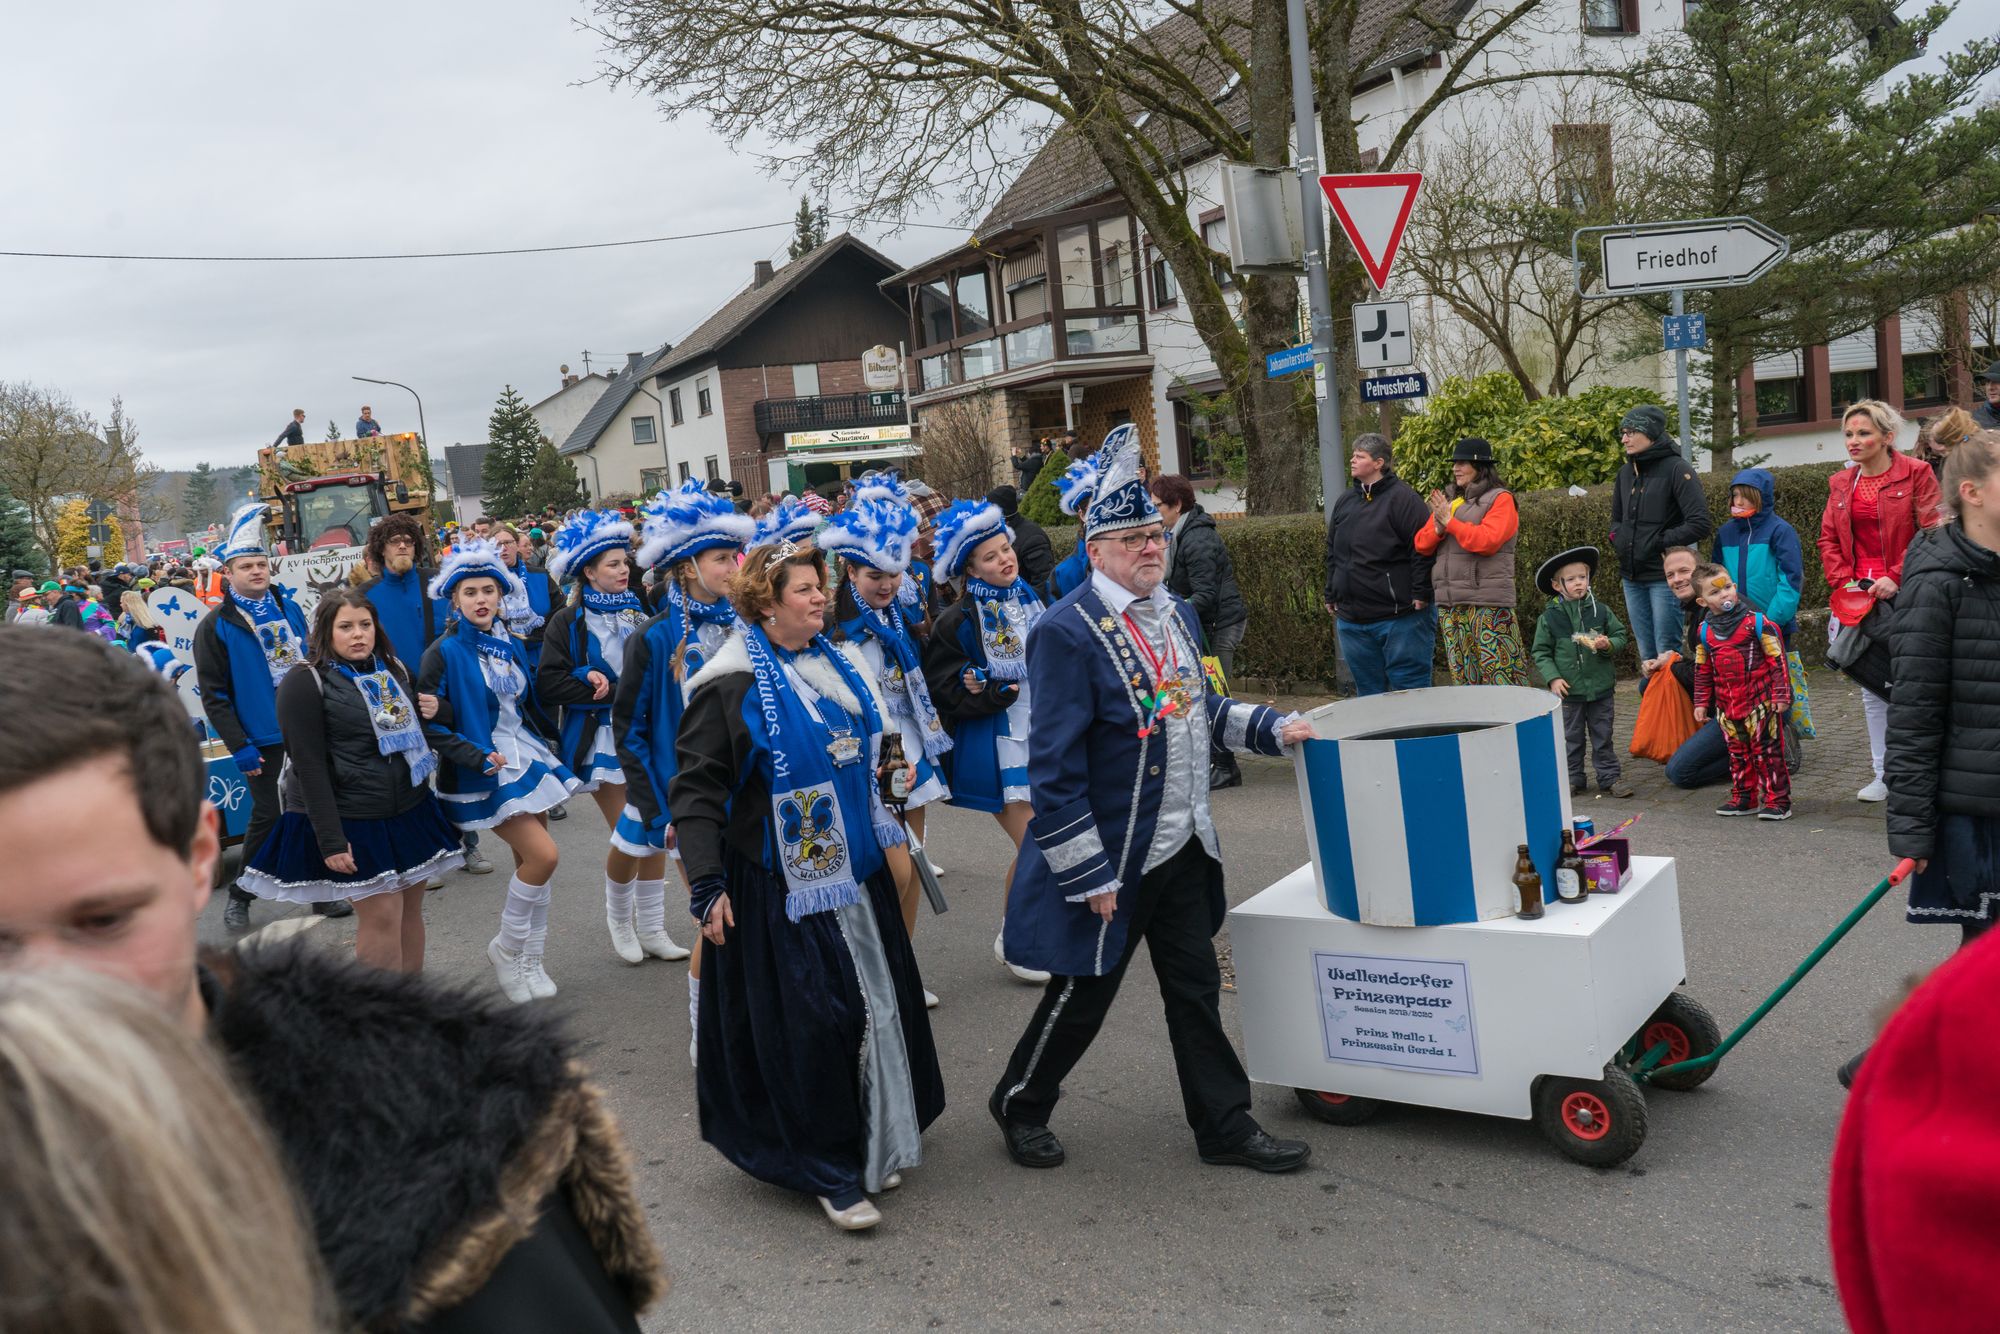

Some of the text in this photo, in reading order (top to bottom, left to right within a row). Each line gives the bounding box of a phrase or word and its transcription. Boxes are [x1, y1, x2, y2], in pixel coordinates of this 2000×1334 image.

[1637, 245, 1718, 270] Friedhof
[1270, 348, 1314, 372] Johanniterstraß
[1366, 377, 1421, 397] Petrusstraße
[828, 431, 870, 443] Sauerwein
[287, 552, 363, 568] KV Hochprozenti
[772, 750, 791, 778] KV
[1328, 967, 1453, 989] Wallendorfer
[1332, 986, 1452, 1009] Prinzenpaar
[1354, 1005, 1387, 1015] Session
[1355, 1027, 1389, 1039] Prinz
[1341, 1037, 1405, 1053] Prinzessin
[1407, 1045, 1444, 1057] Gerda
